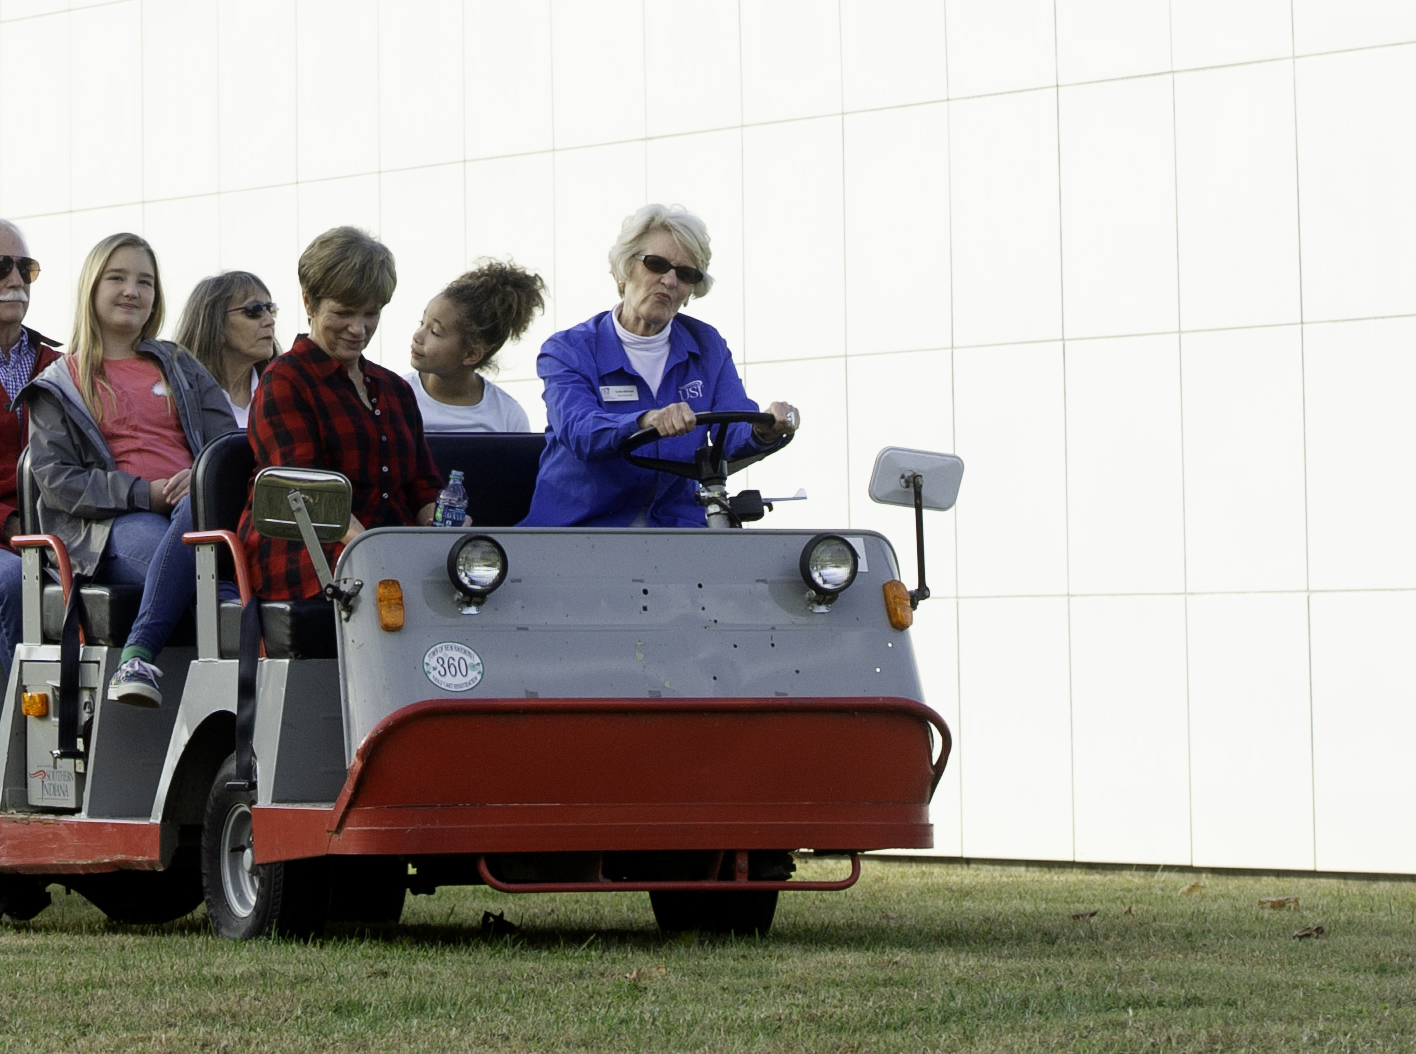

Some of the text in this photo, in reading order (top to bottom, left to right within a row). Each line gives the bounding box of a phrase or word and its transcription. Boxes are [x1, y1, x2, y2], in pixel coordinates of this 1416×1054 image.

[679, 382, 703, 401] USI
[436, 656, 468, 677] 360
[45, 770, 74, 782] SOUTHERN
[41, 780, 69, 800] INDIANA
